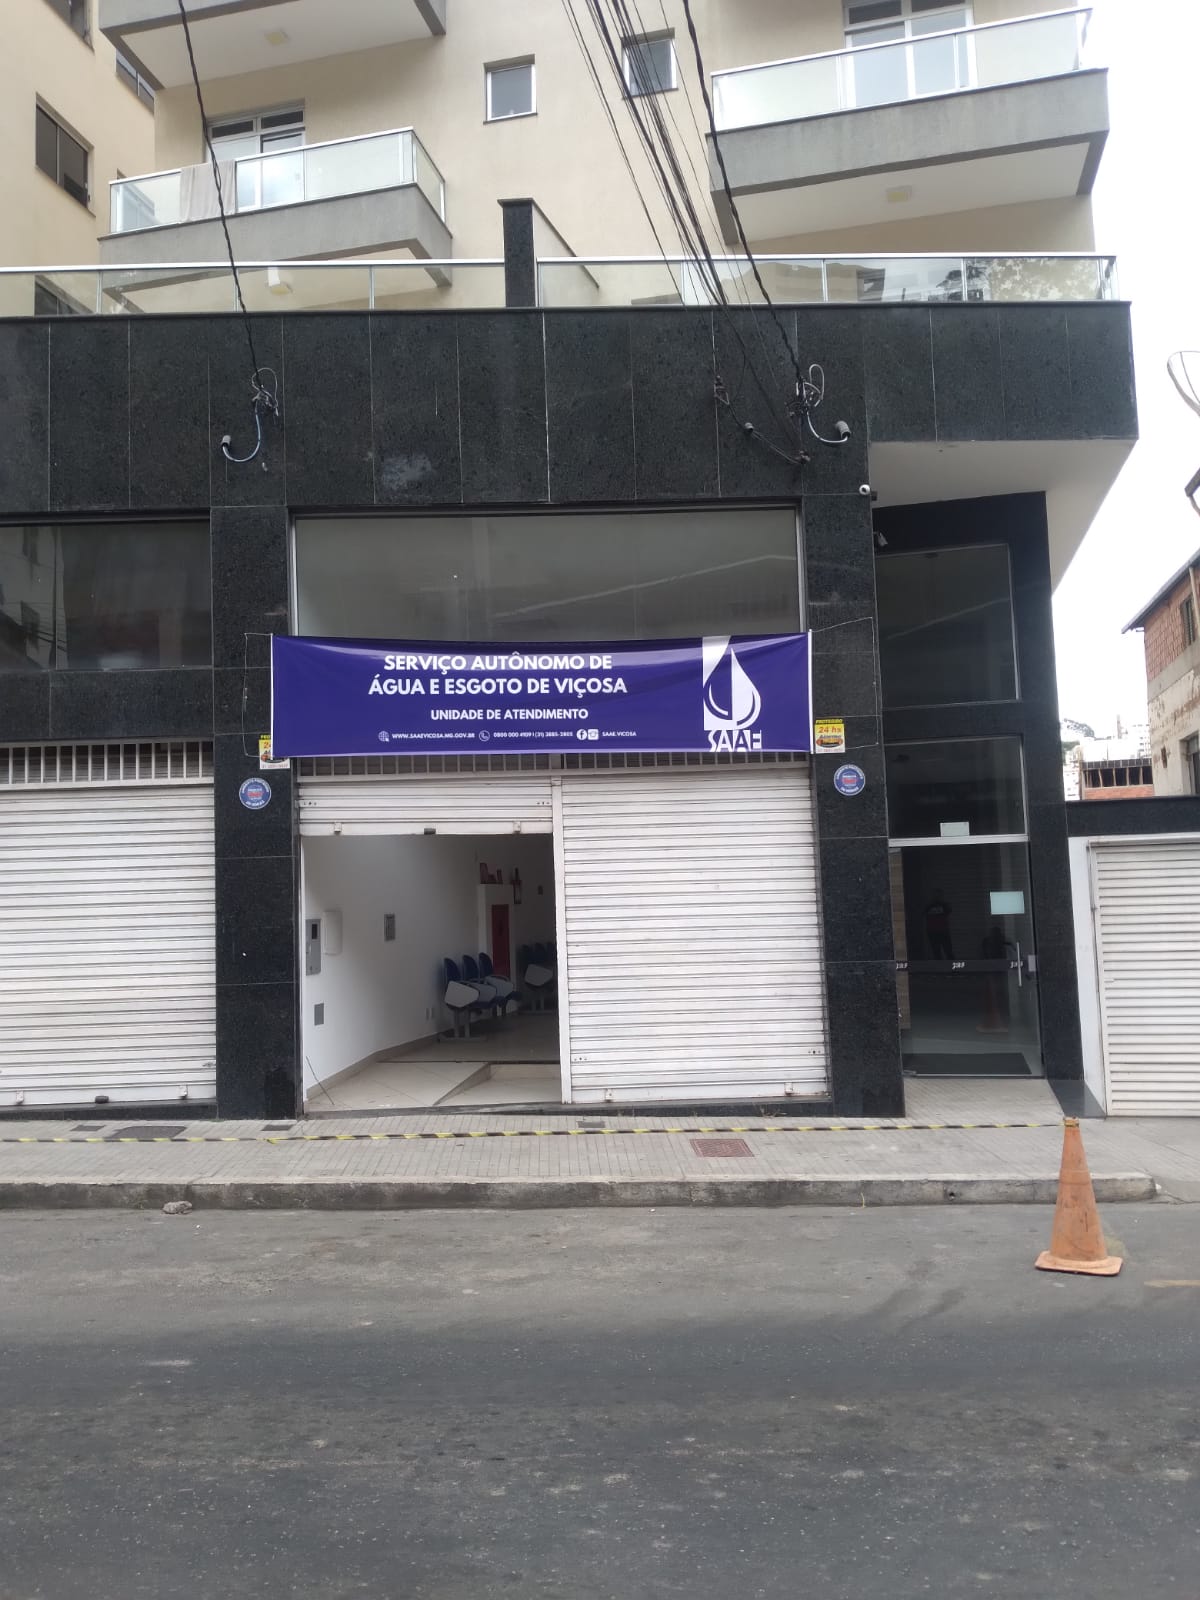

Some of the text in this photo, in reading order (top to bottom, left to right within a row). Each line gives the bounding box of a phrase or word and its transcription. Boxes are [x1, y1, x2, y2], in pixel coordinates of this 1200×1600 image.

[384, 651, 613, 675] SERVIÇO AUTÔNOMO DE
[368, 674, 628, 698] ÁGUA E ESGOTO DE VIÇOSA
[430, 708, 589, 720] UNIDADE DE ATENDIMENTO
[707, 729, 762, 752] SAAE
